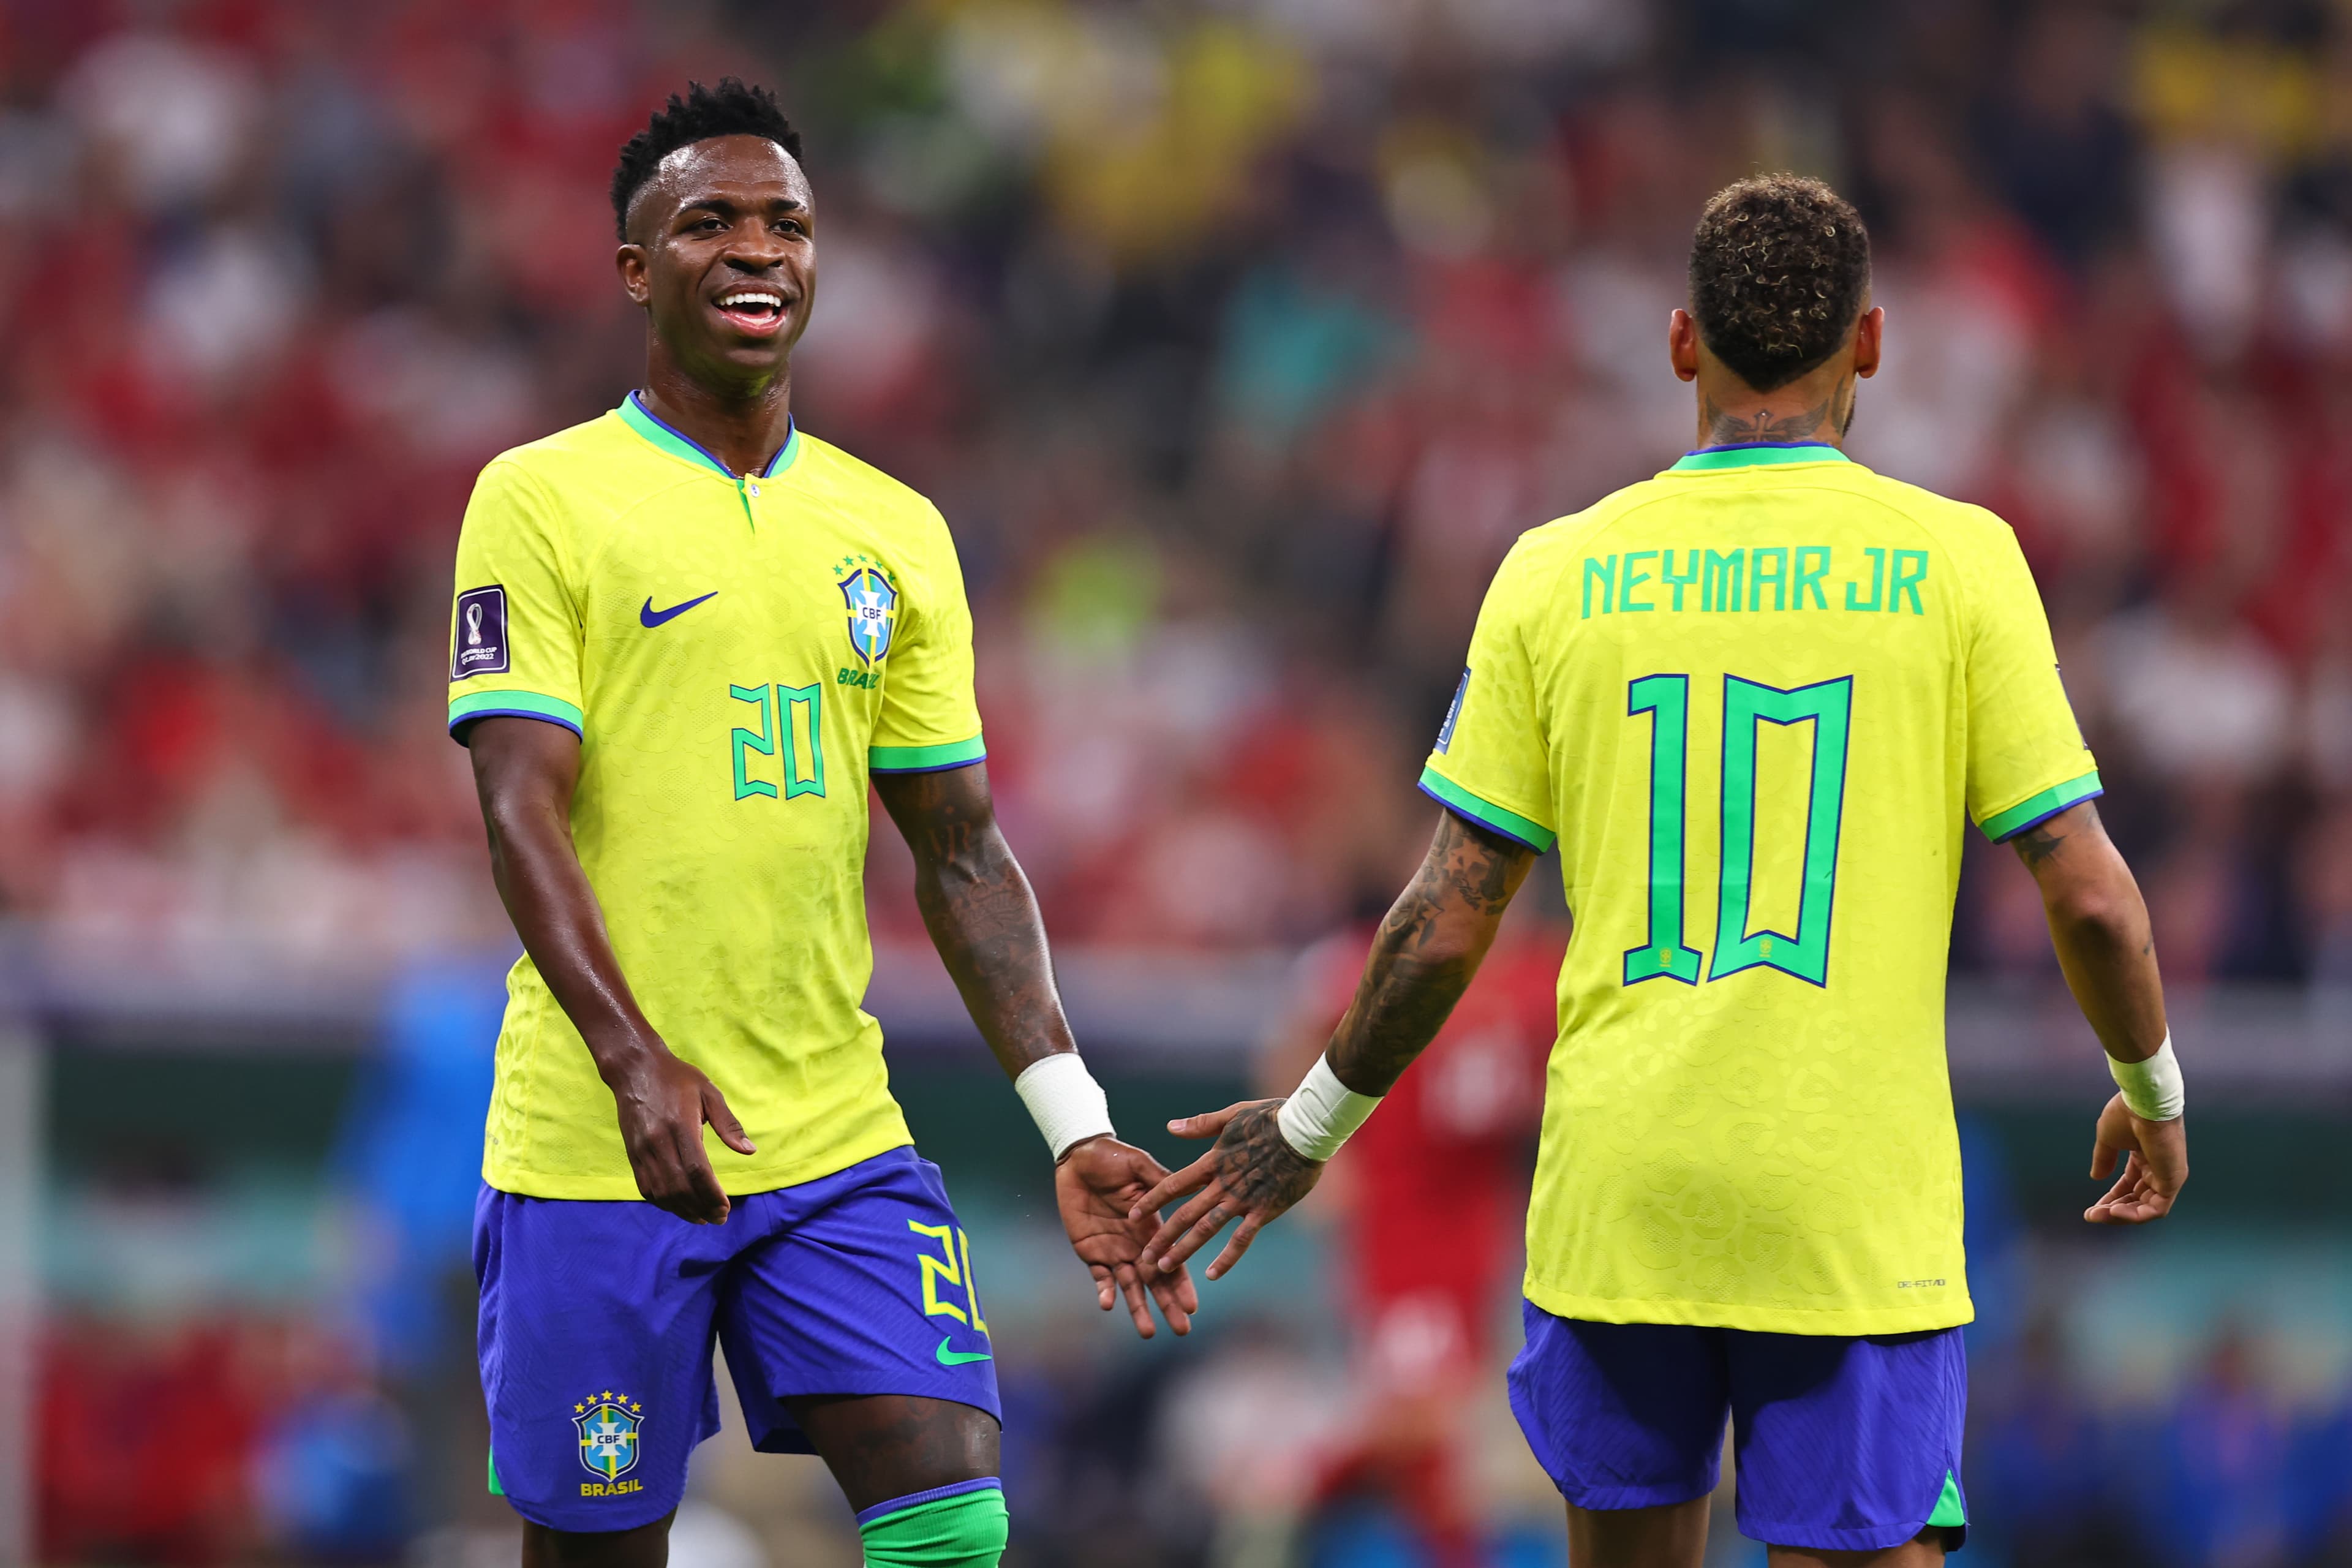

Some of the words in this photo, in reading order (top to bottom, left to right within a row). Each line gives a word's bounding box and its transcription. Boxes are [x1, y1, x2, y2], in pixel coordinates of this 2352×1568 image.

[1581, 546, 1831, 619] NEYMAR
[1845, 547, 1929, 616] JR
[862, 607, 881, 620] CBF
[729, 682, 826, 801] 20
[1623, 672, 1853, 989] 10
[597, 1434, 620, 1444] CBF
[580, 1479, 644, 1497] BRASIL
